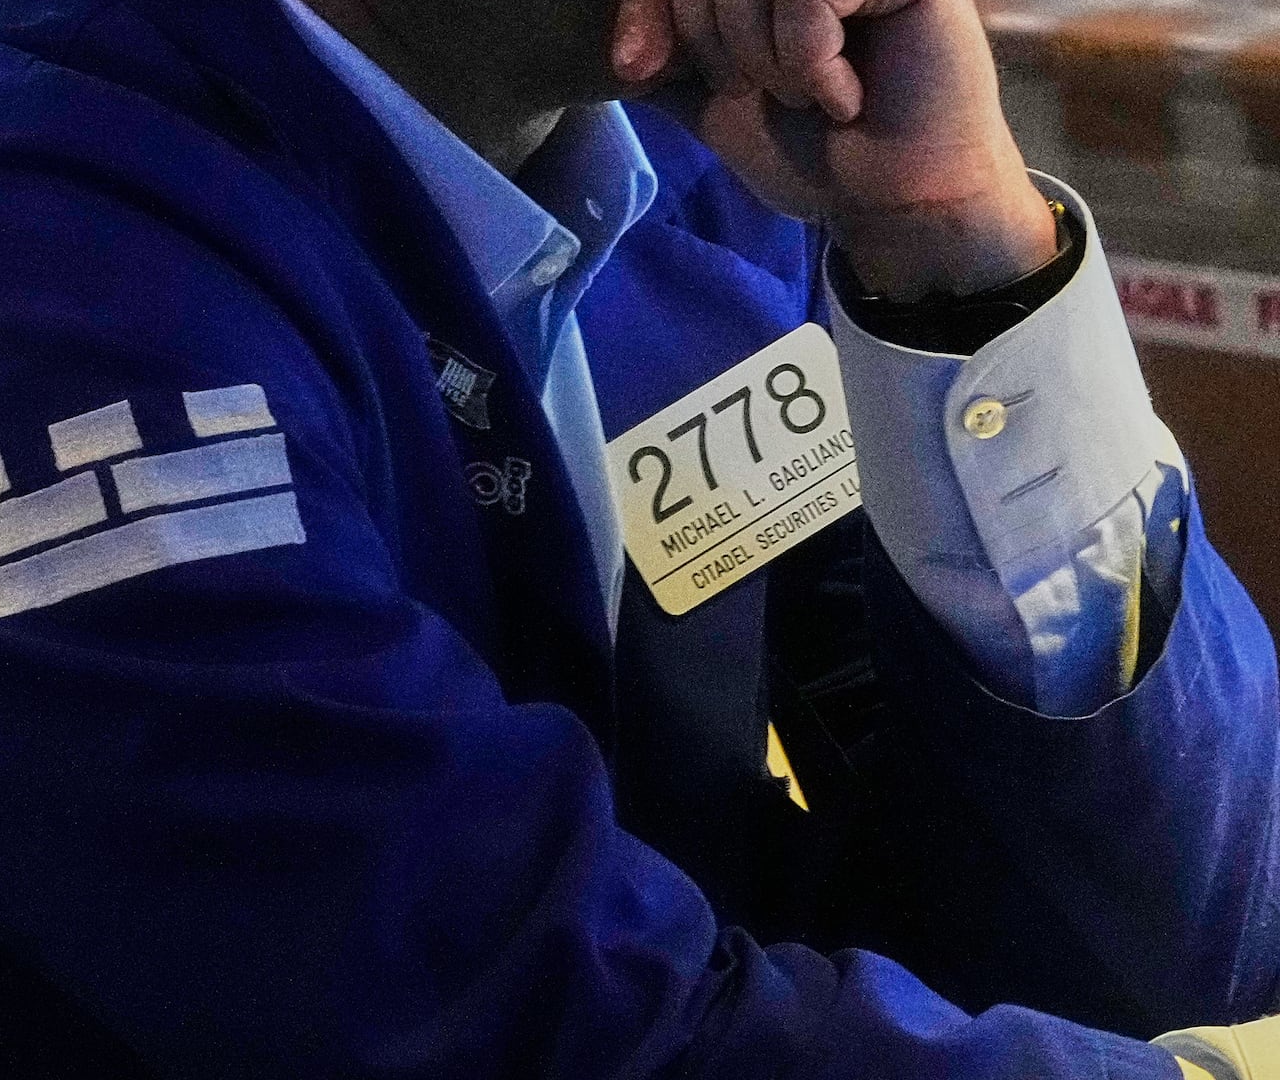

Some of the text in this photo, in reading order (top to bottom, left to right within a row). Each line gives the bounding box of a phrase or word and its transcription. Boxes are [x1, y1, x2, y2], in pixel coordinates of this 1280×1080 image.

[627, 363, 827, 525] 2778
[660, 429, 856, 558] MICHAEL L. GAGLIANO
[691, 478, 862, 589] CITADEL SECURITIES LL
